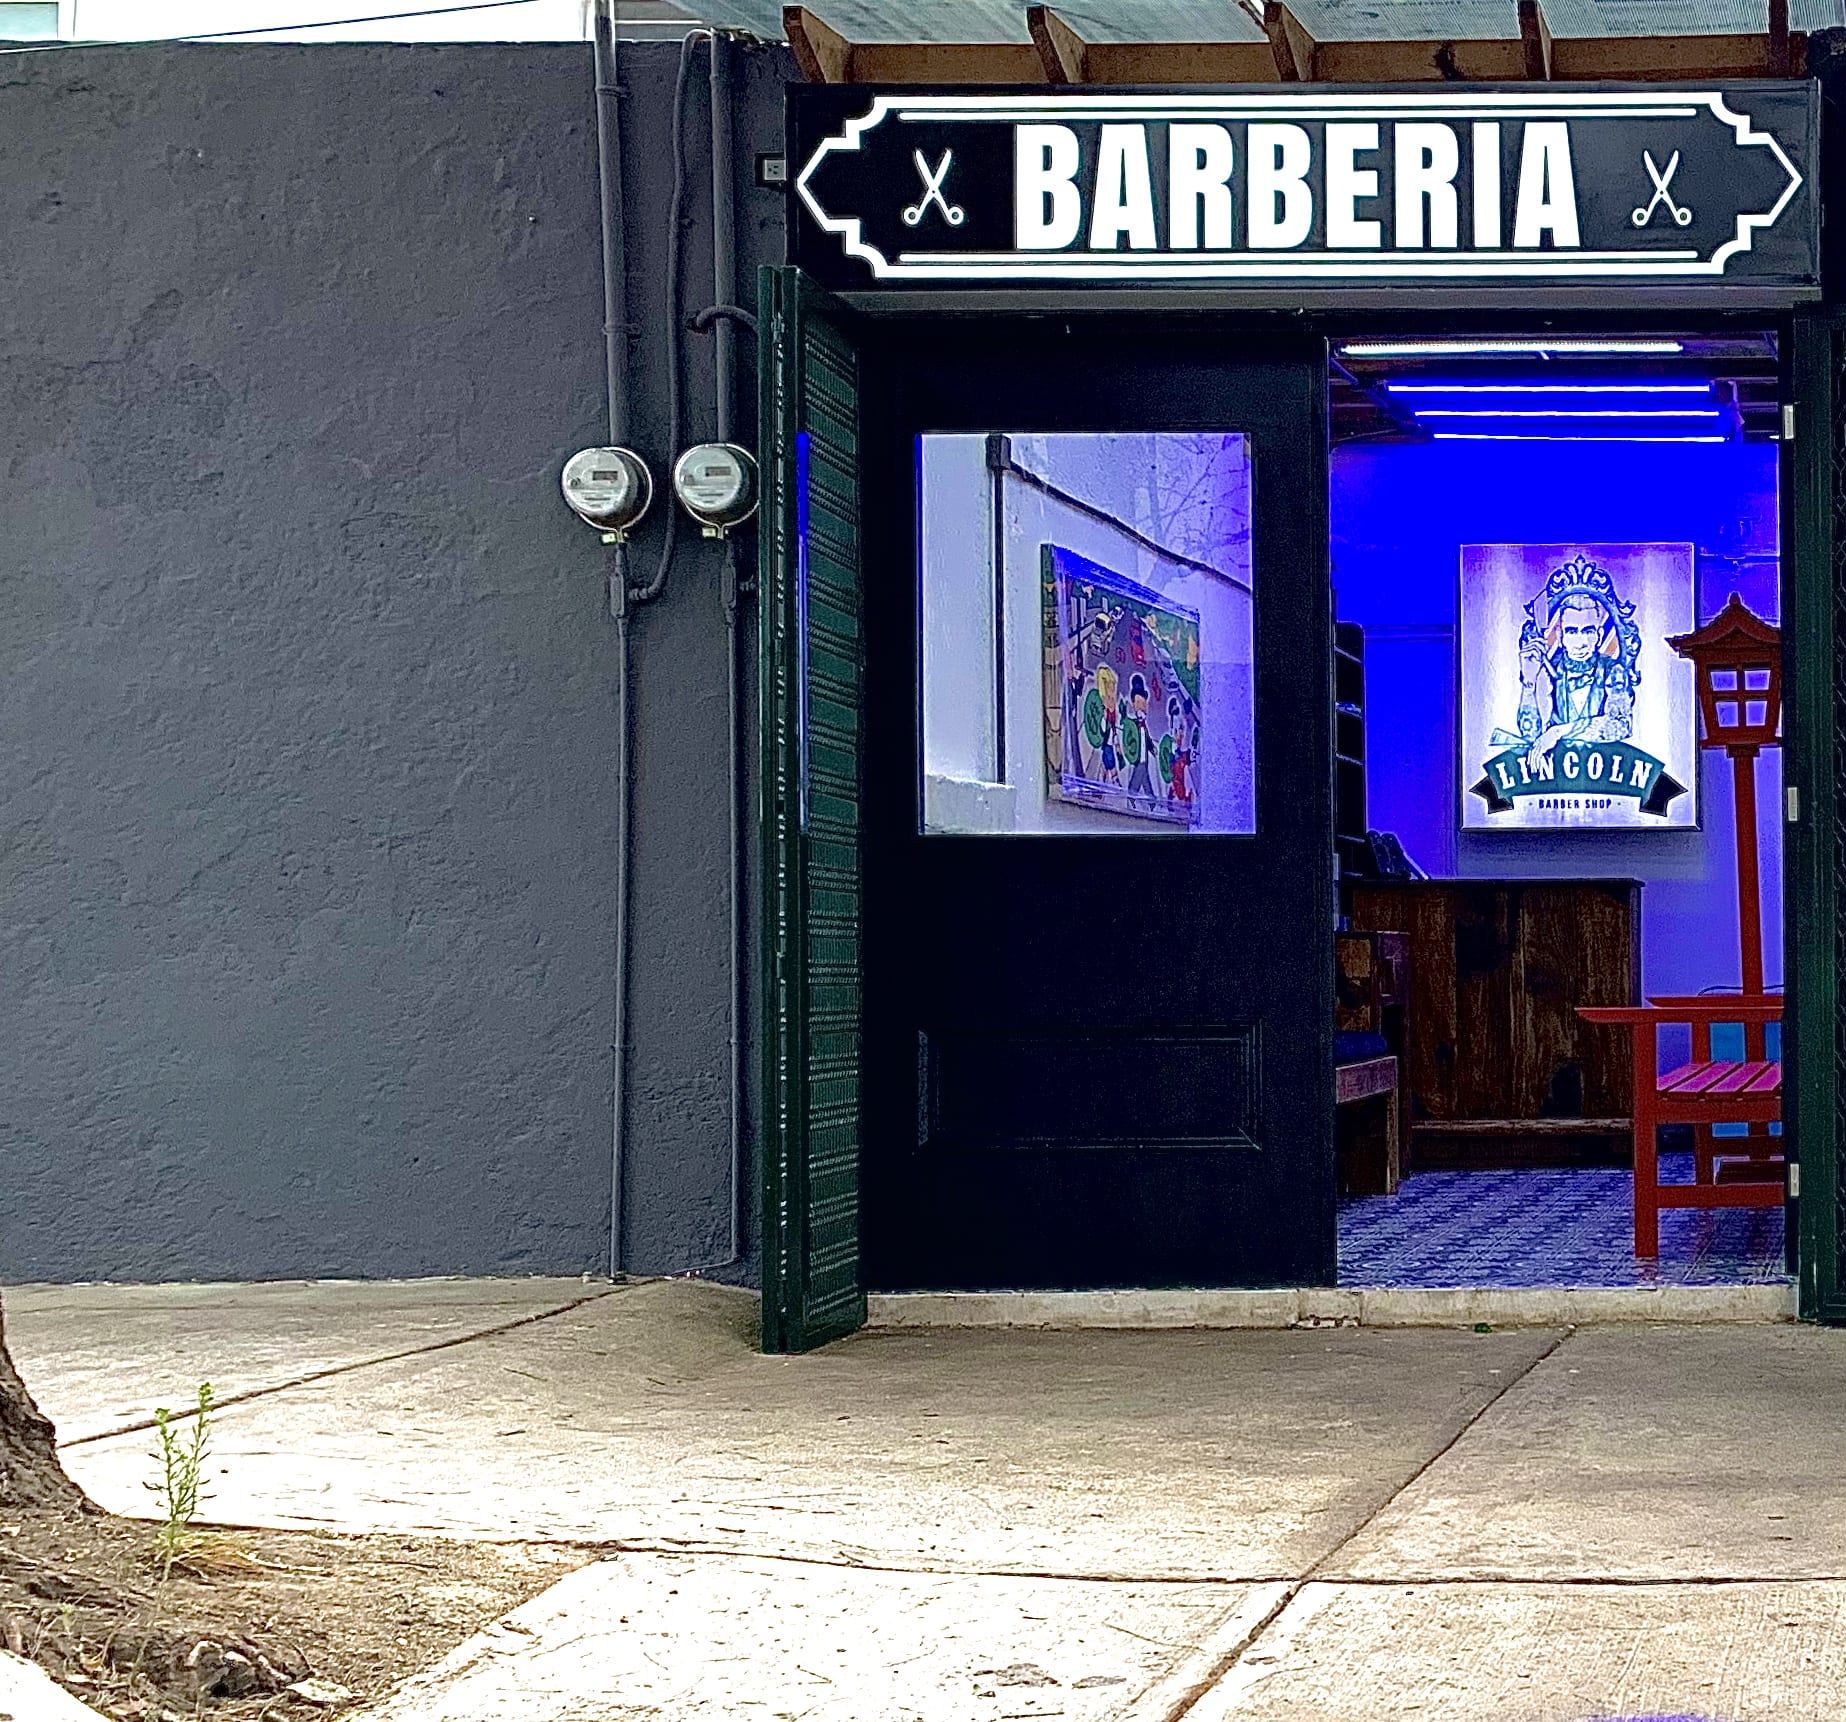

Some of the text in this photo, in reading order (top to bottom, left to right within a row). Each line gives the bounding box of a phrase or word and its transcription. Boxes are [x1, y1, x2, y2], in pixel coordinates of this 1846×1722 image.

[1014, 121, 1580, 250] BARBERIA
[1495, 751, 1653, 790] LINCOLN
[1538, 798, 1612, 809] BARBER SHOP
